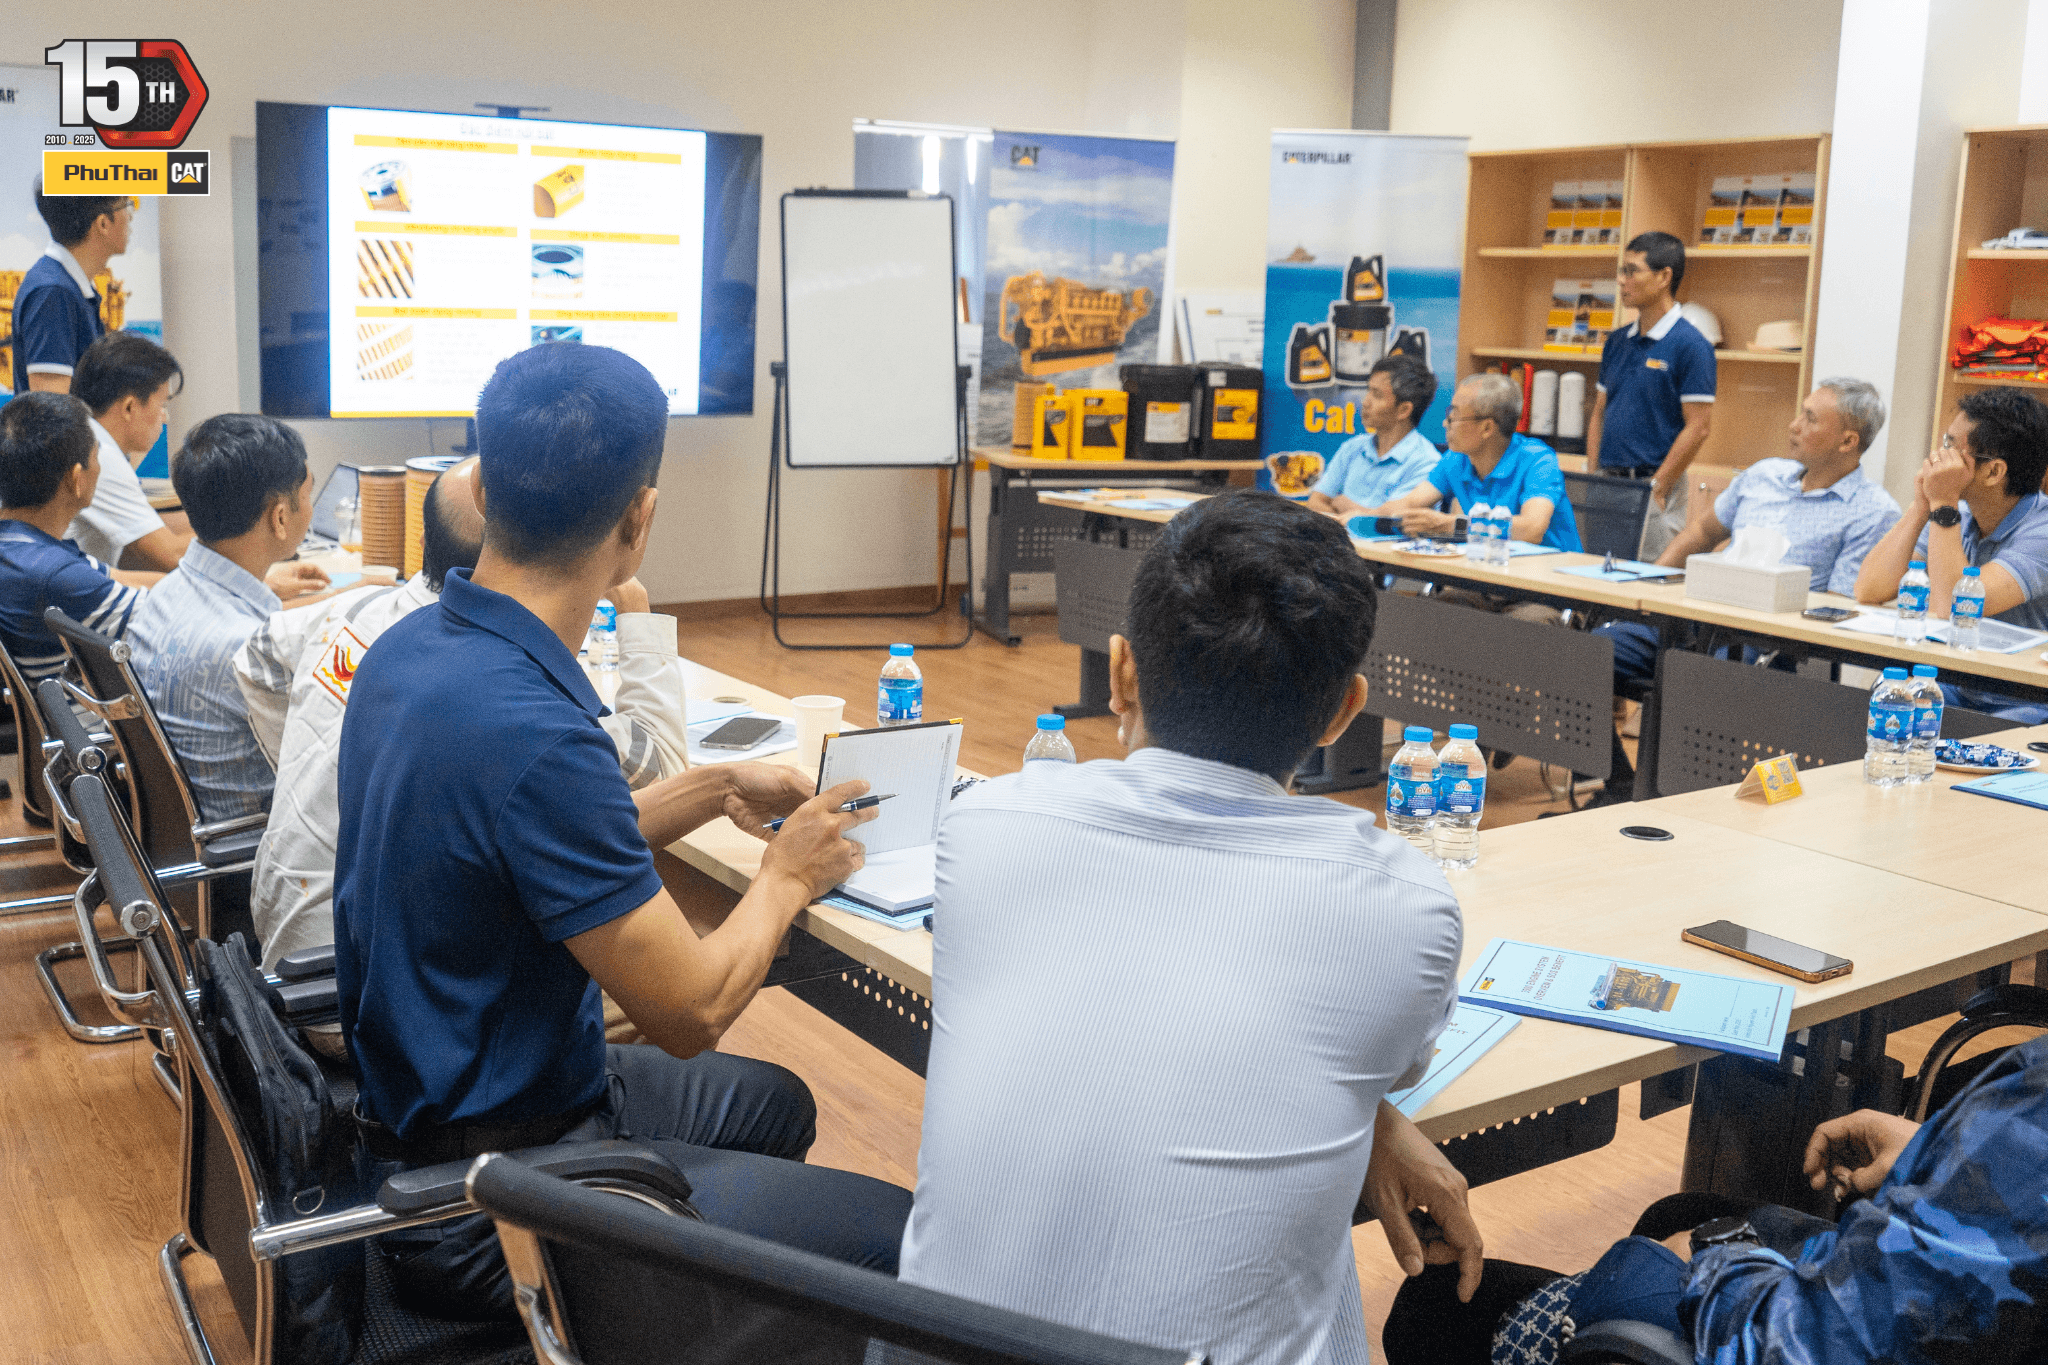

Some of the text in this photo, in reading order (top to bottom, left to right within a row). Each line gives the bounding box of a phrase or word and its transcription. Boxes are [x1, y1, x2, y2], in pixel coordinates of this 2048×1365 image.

[1011, 145, 1040, 165] CAT
[1283, 151, 1352, 164] CATERPILLAR
[1304, 398, 1356, 434] Cat
